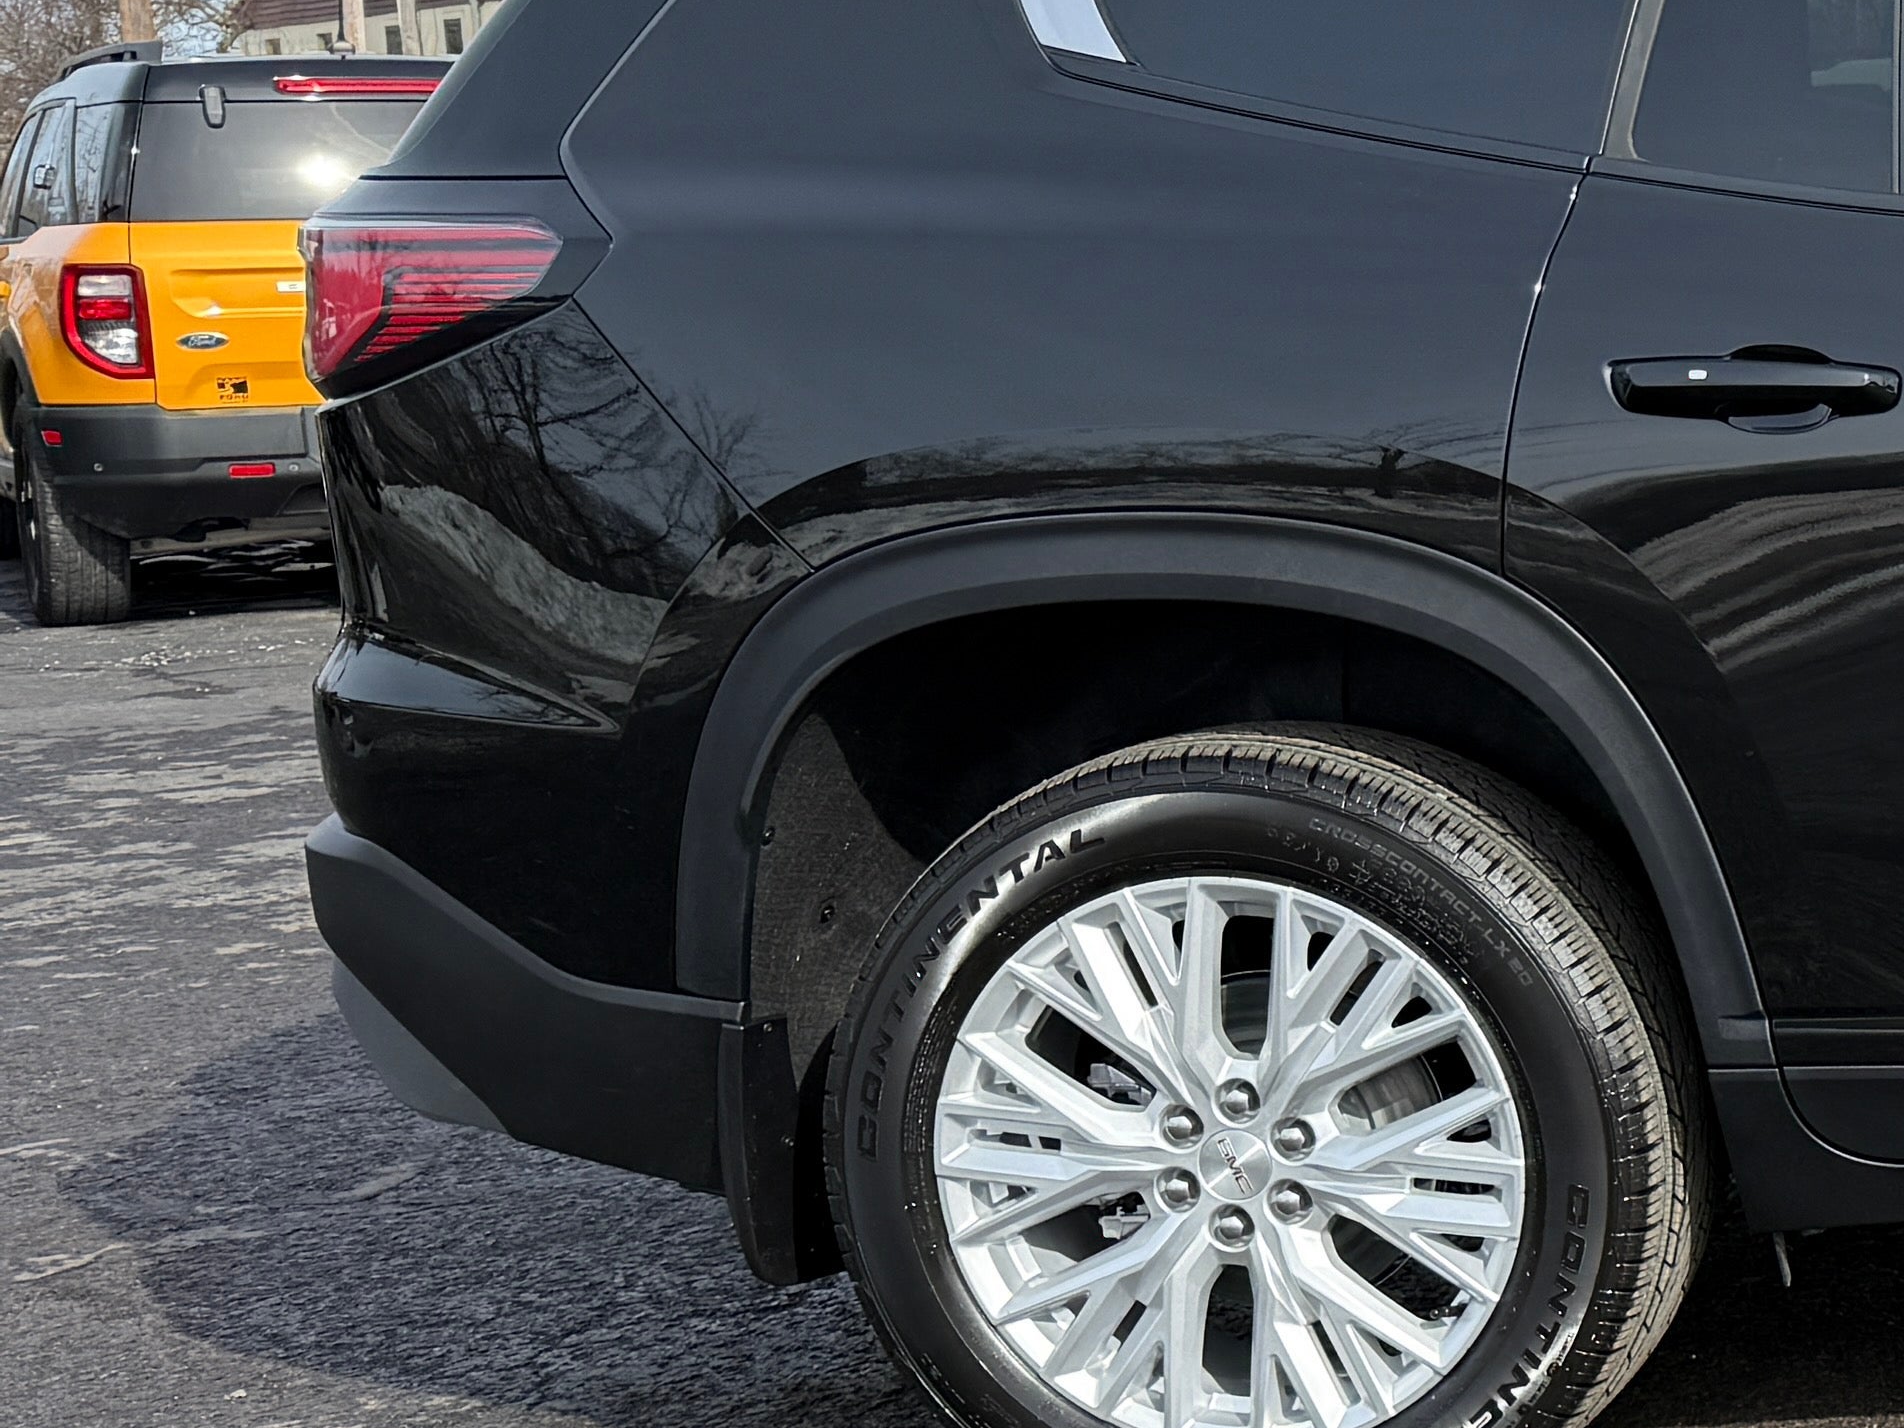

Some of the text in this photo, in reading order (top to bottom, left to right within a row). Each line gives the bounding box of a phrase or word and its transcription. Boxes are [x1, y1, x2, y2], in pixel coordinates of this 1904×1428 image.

[1309, 818, 1483, 925] CROSSCONTACT
[856, 828, 1107, 1162] CONTINENTAL
[1217, 1137, 1253, 1195] GMC
